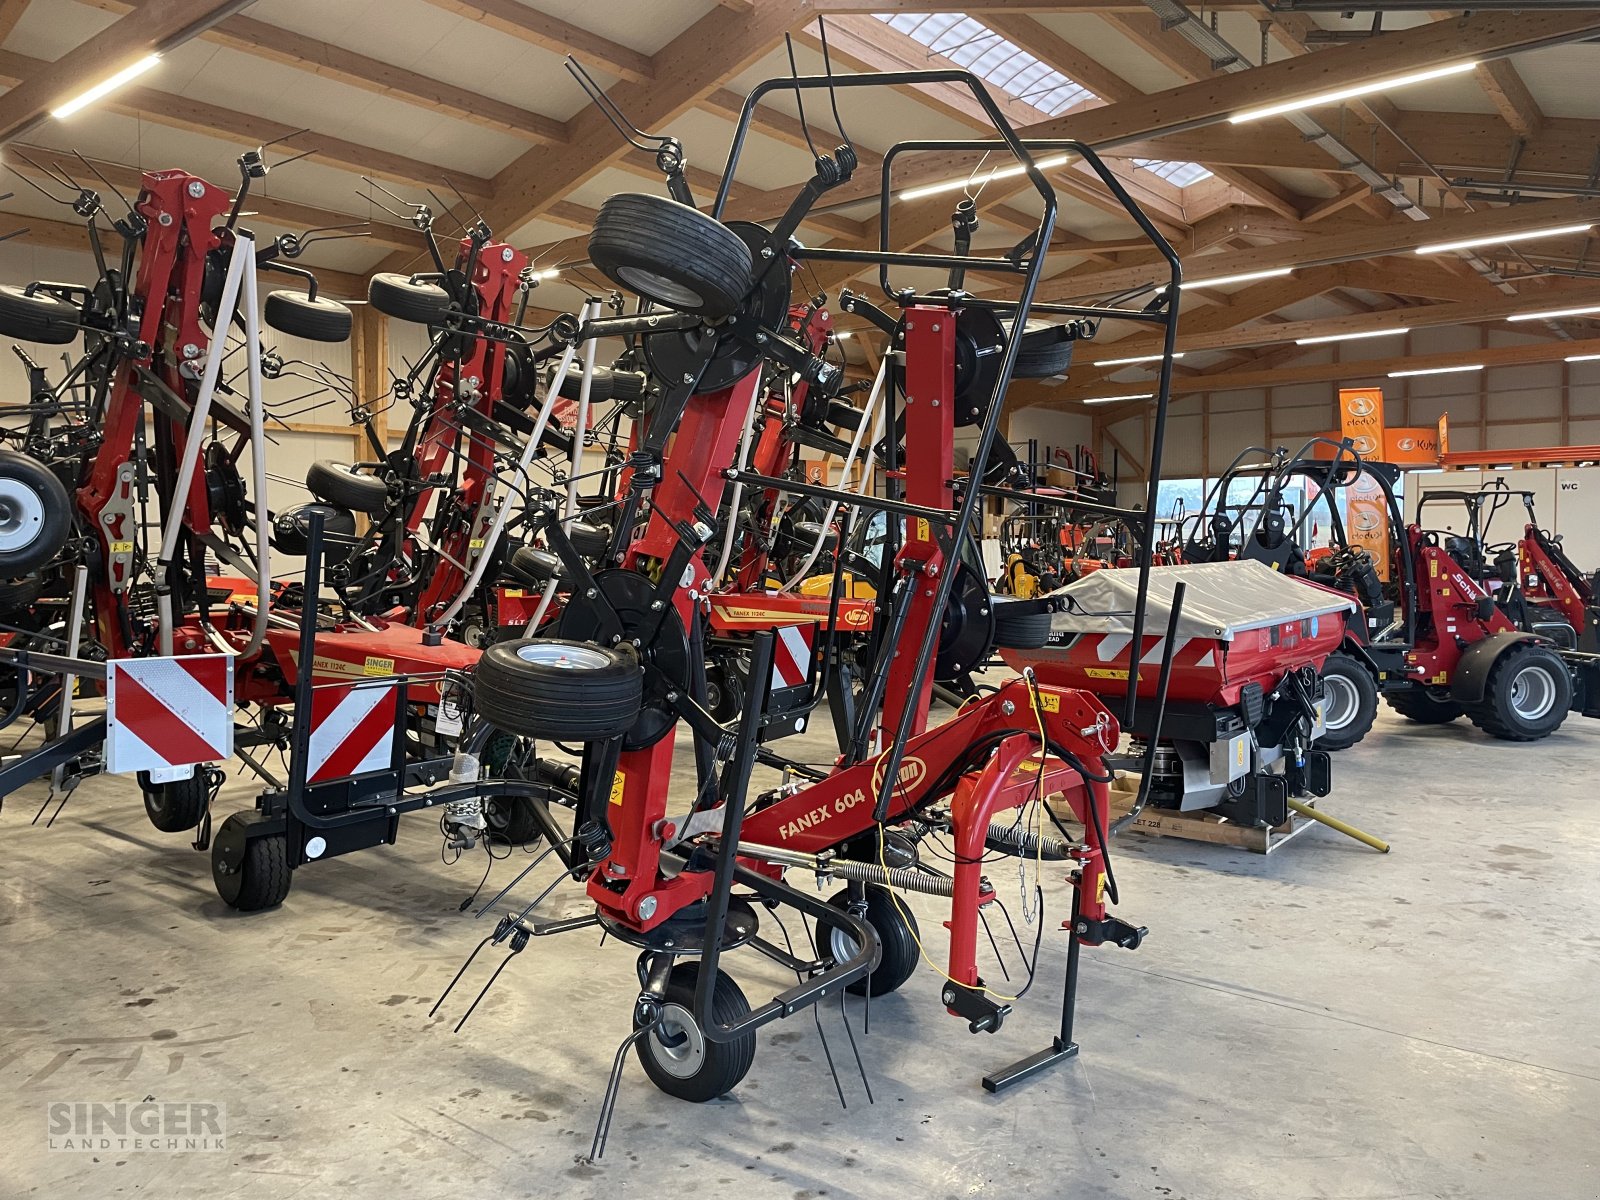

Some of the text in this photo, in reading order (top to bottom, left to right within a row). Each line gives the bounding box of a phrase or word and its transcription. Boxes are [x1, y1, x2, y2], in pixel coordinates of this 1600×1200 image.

[1452, 573, 1477, 603] Schä
[313, 660, 328, 669] ANEX
[366, 658, 393, 669] SINGER
[778, 788, 866, 840] FANEX 604
[1148, 820, 1161, 828] 228
